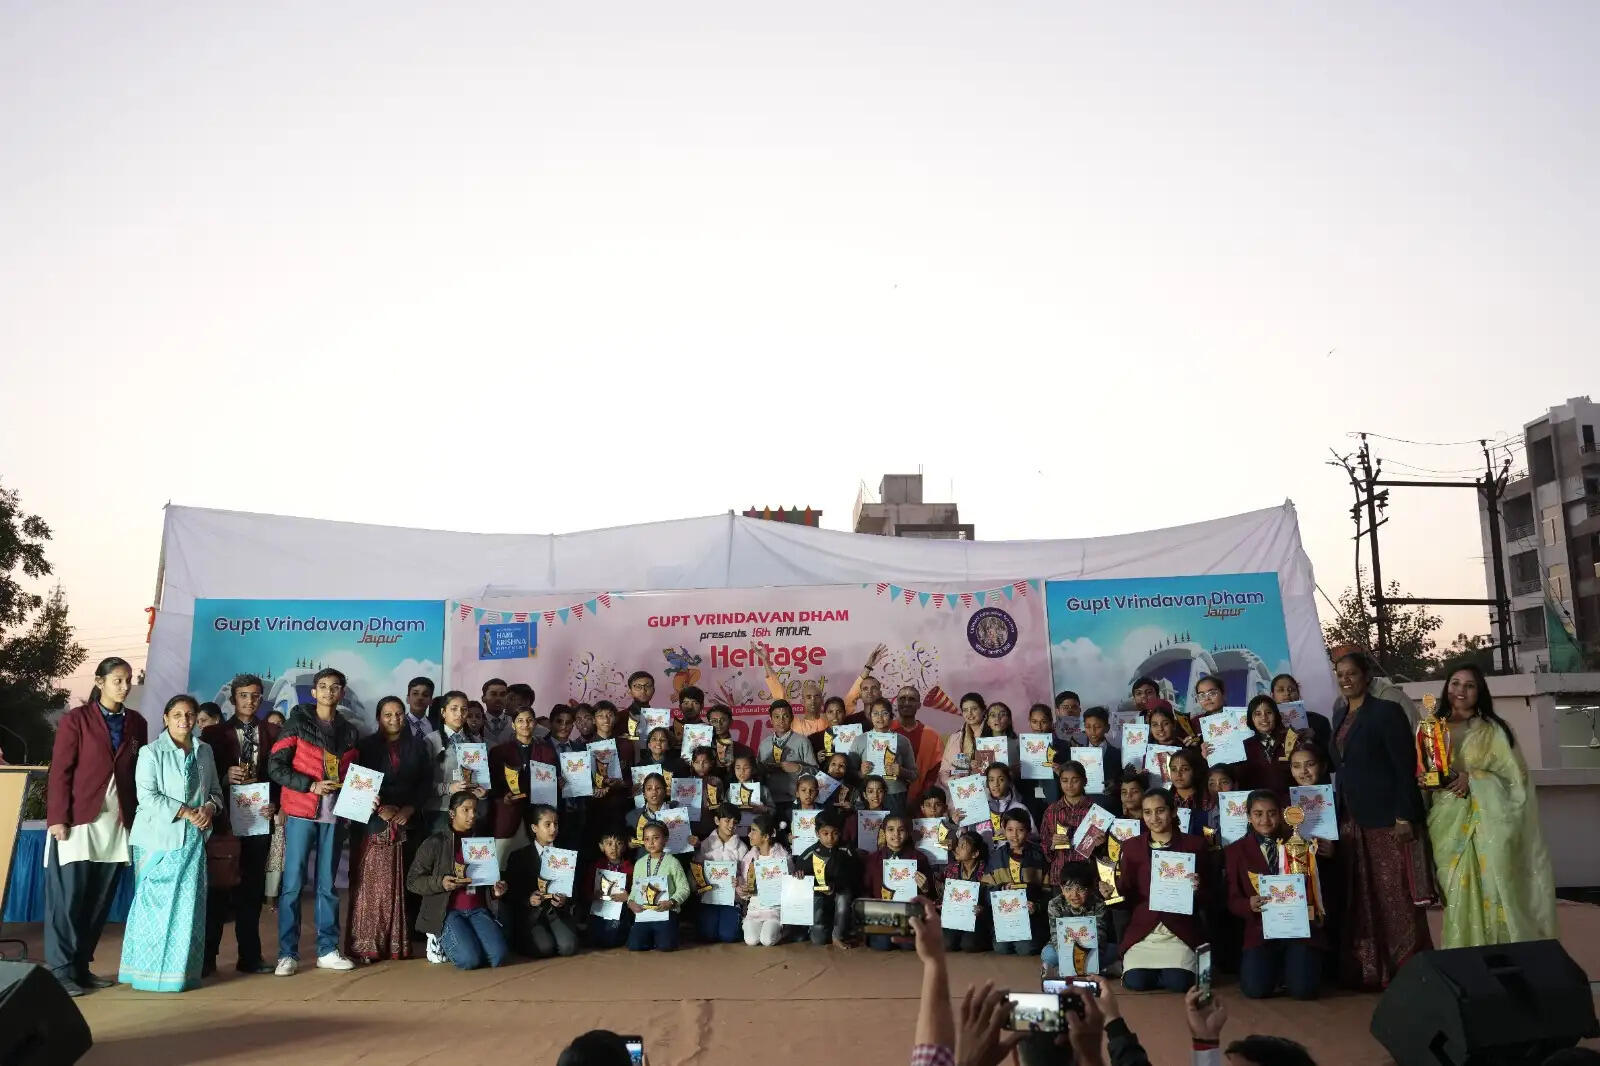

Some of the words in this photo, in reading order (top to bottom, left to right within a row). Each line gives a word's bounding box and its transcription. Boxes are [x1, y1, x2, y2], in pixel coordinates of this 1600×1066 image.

[1066, 597, 1110, 614] Gupt
[1115, 593, 1206, 609] Vrindavan
[1212, 591, 1264, 604] Dham
[1204, 600, 1245, 620] Jaipur
[214, 617, 261, 634] Gupt
[266, 617, 364, 632] Vrindavan
[369, 617, 425, 631] Dham
[648, 614, 691, 628] GUPT
[694, 611, 795, 625] VRINDAVAN
[800, 609, 849, 623] DHAM
[357, 624, 403, 647] Jaipur
[700, 628, 748, 642] presents
[752, 627, 771, 637] 16th
[775, 626, 812, 637] ANNUAL
[711, 641, 827, 674] Heritage
